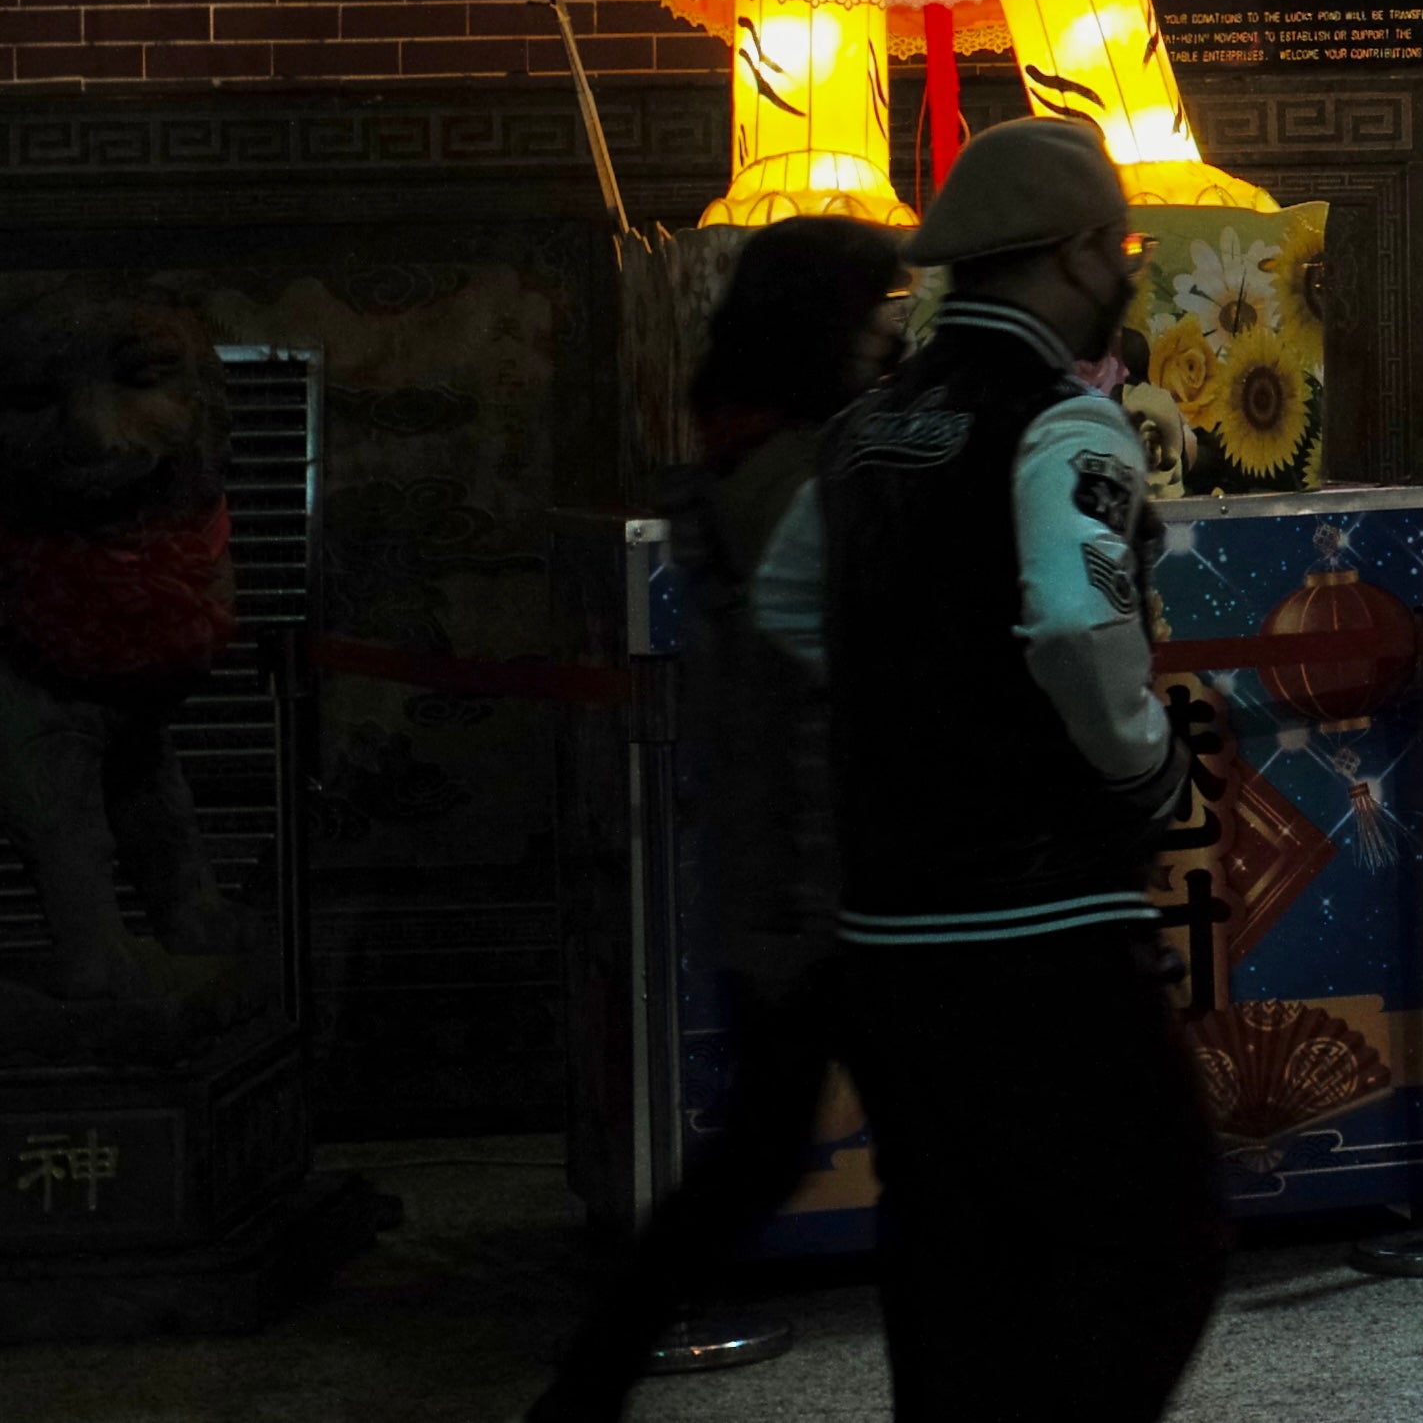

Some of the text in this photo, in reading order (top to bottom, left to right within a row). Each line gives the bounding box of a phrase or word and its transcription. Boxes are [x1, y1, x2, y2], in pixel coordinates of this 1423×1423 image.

[1191, 12, 1242, 25] DONATIONS
[1247, 11, 1260, 23] TO
[1264, 11, 1281, 23] THE
[1285, 10, 1313, 23] LUCKY
[1317, 10, 1341, 22] POND
[1346, 10, 1367, 22] WILL
[1372, 10, 1384, 21] BE
[1213, 31, 1259, 44] MOVEMENT
[1265, 31, 1276, 43] TO
[1280, 30, 1331, 43] ESTABLISH
[1334, 30, 1347, 41] OR
[1351, 29, 1389, 41] SUPPORT
[1395, 28, 1412, 40] THE
[1279, 48, 1321, 60] WELCOME
[1324, 48, 1348, 59] YOUR
[1351, 46, 1422, 59] CONTRIBUTIONS
